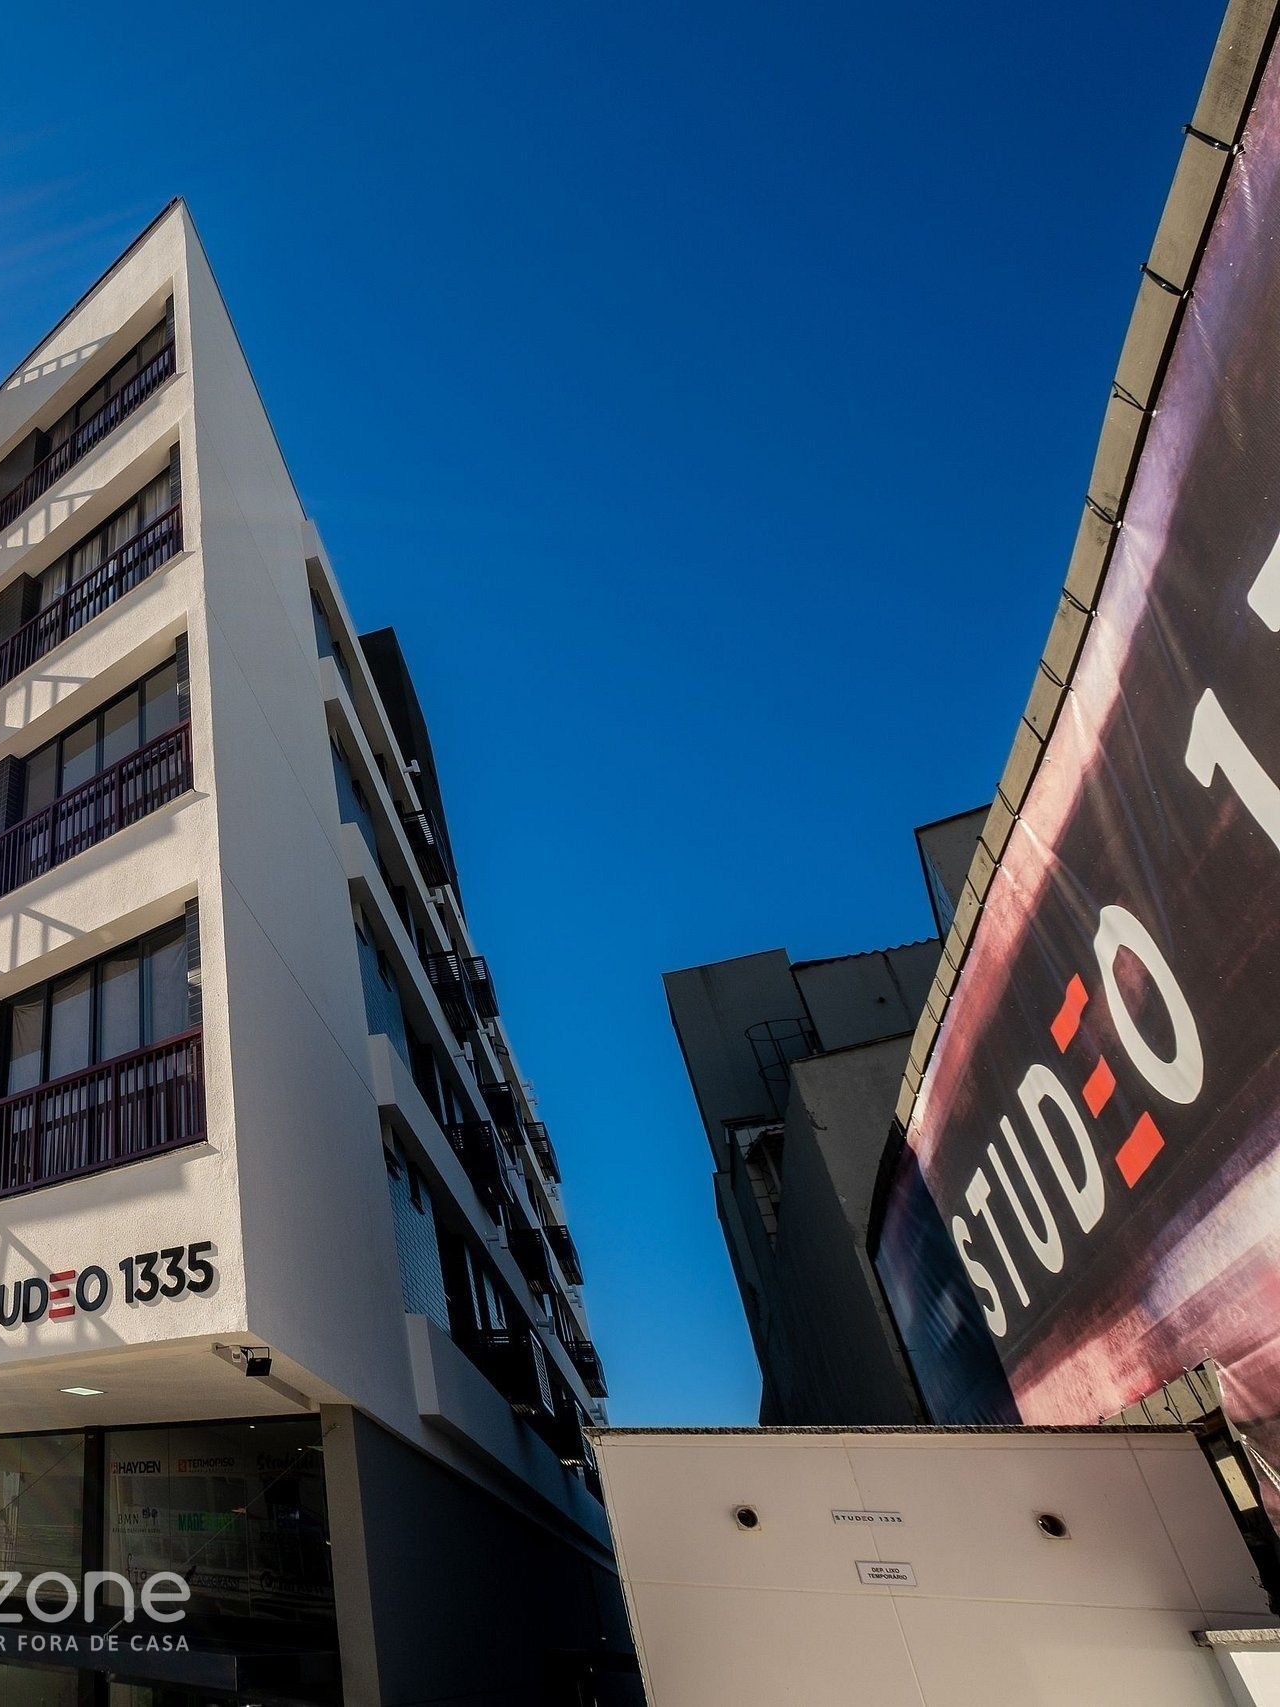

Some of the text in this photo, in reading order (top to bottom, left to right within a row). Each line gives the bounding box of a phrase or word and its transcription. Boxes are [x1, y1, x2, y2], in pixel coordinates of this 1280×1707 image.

[952, 904, 1204, 1337] STUDEO
[119, 1241, 215, 1304] 1335
[120, 1460, 161, 1474] HAYDEN
